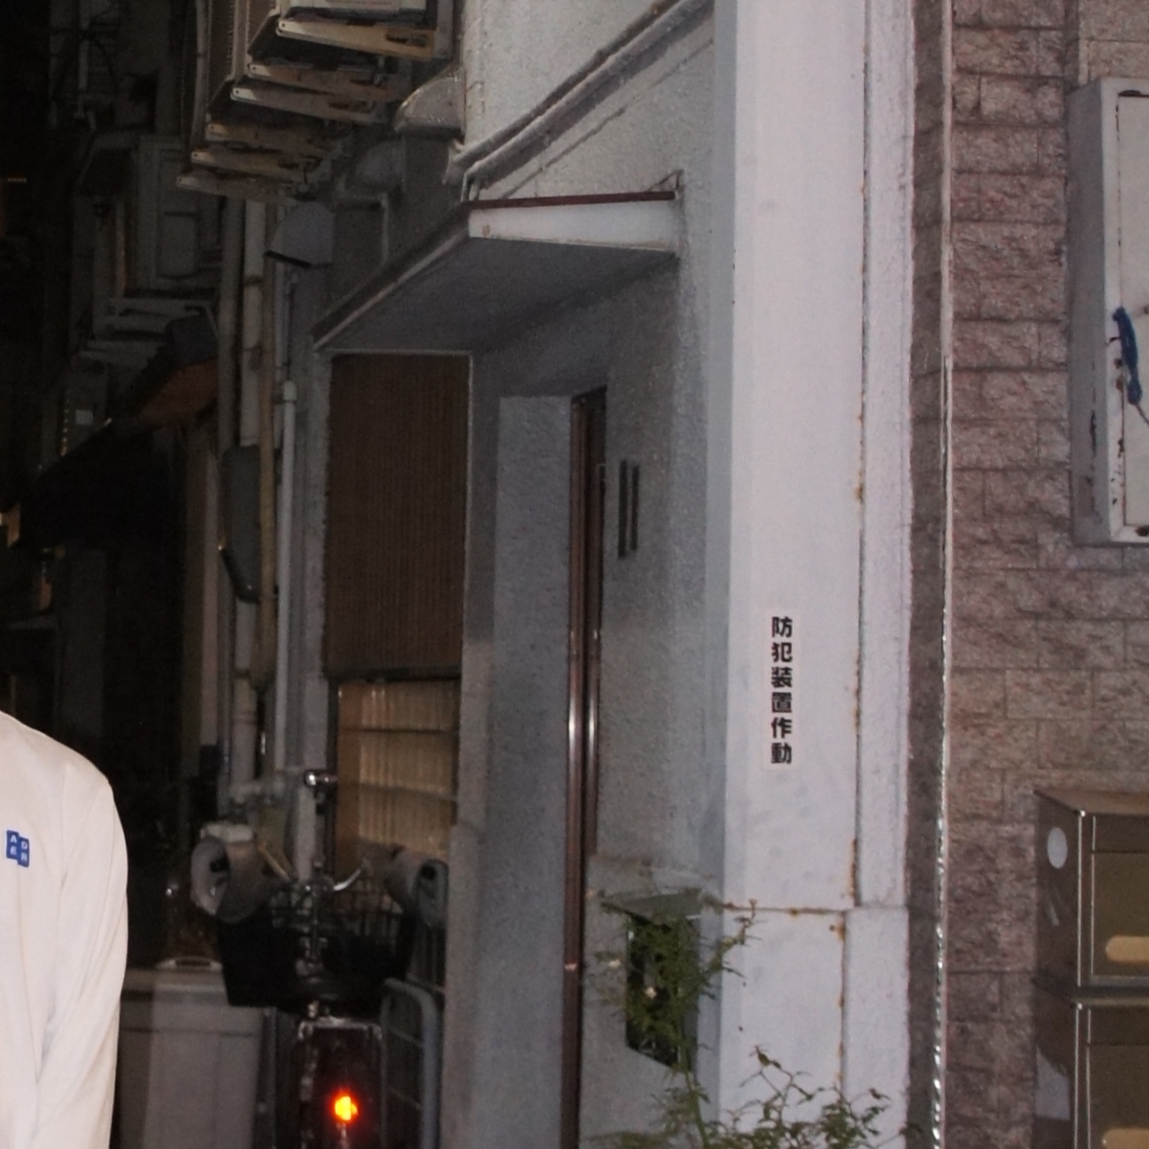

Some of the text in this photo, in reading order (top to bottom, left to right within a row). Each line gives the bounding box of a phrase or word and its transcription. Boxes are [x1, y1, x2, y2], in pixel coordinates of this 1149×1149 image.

[771, 616, 793, 764] 防犯装置作動
